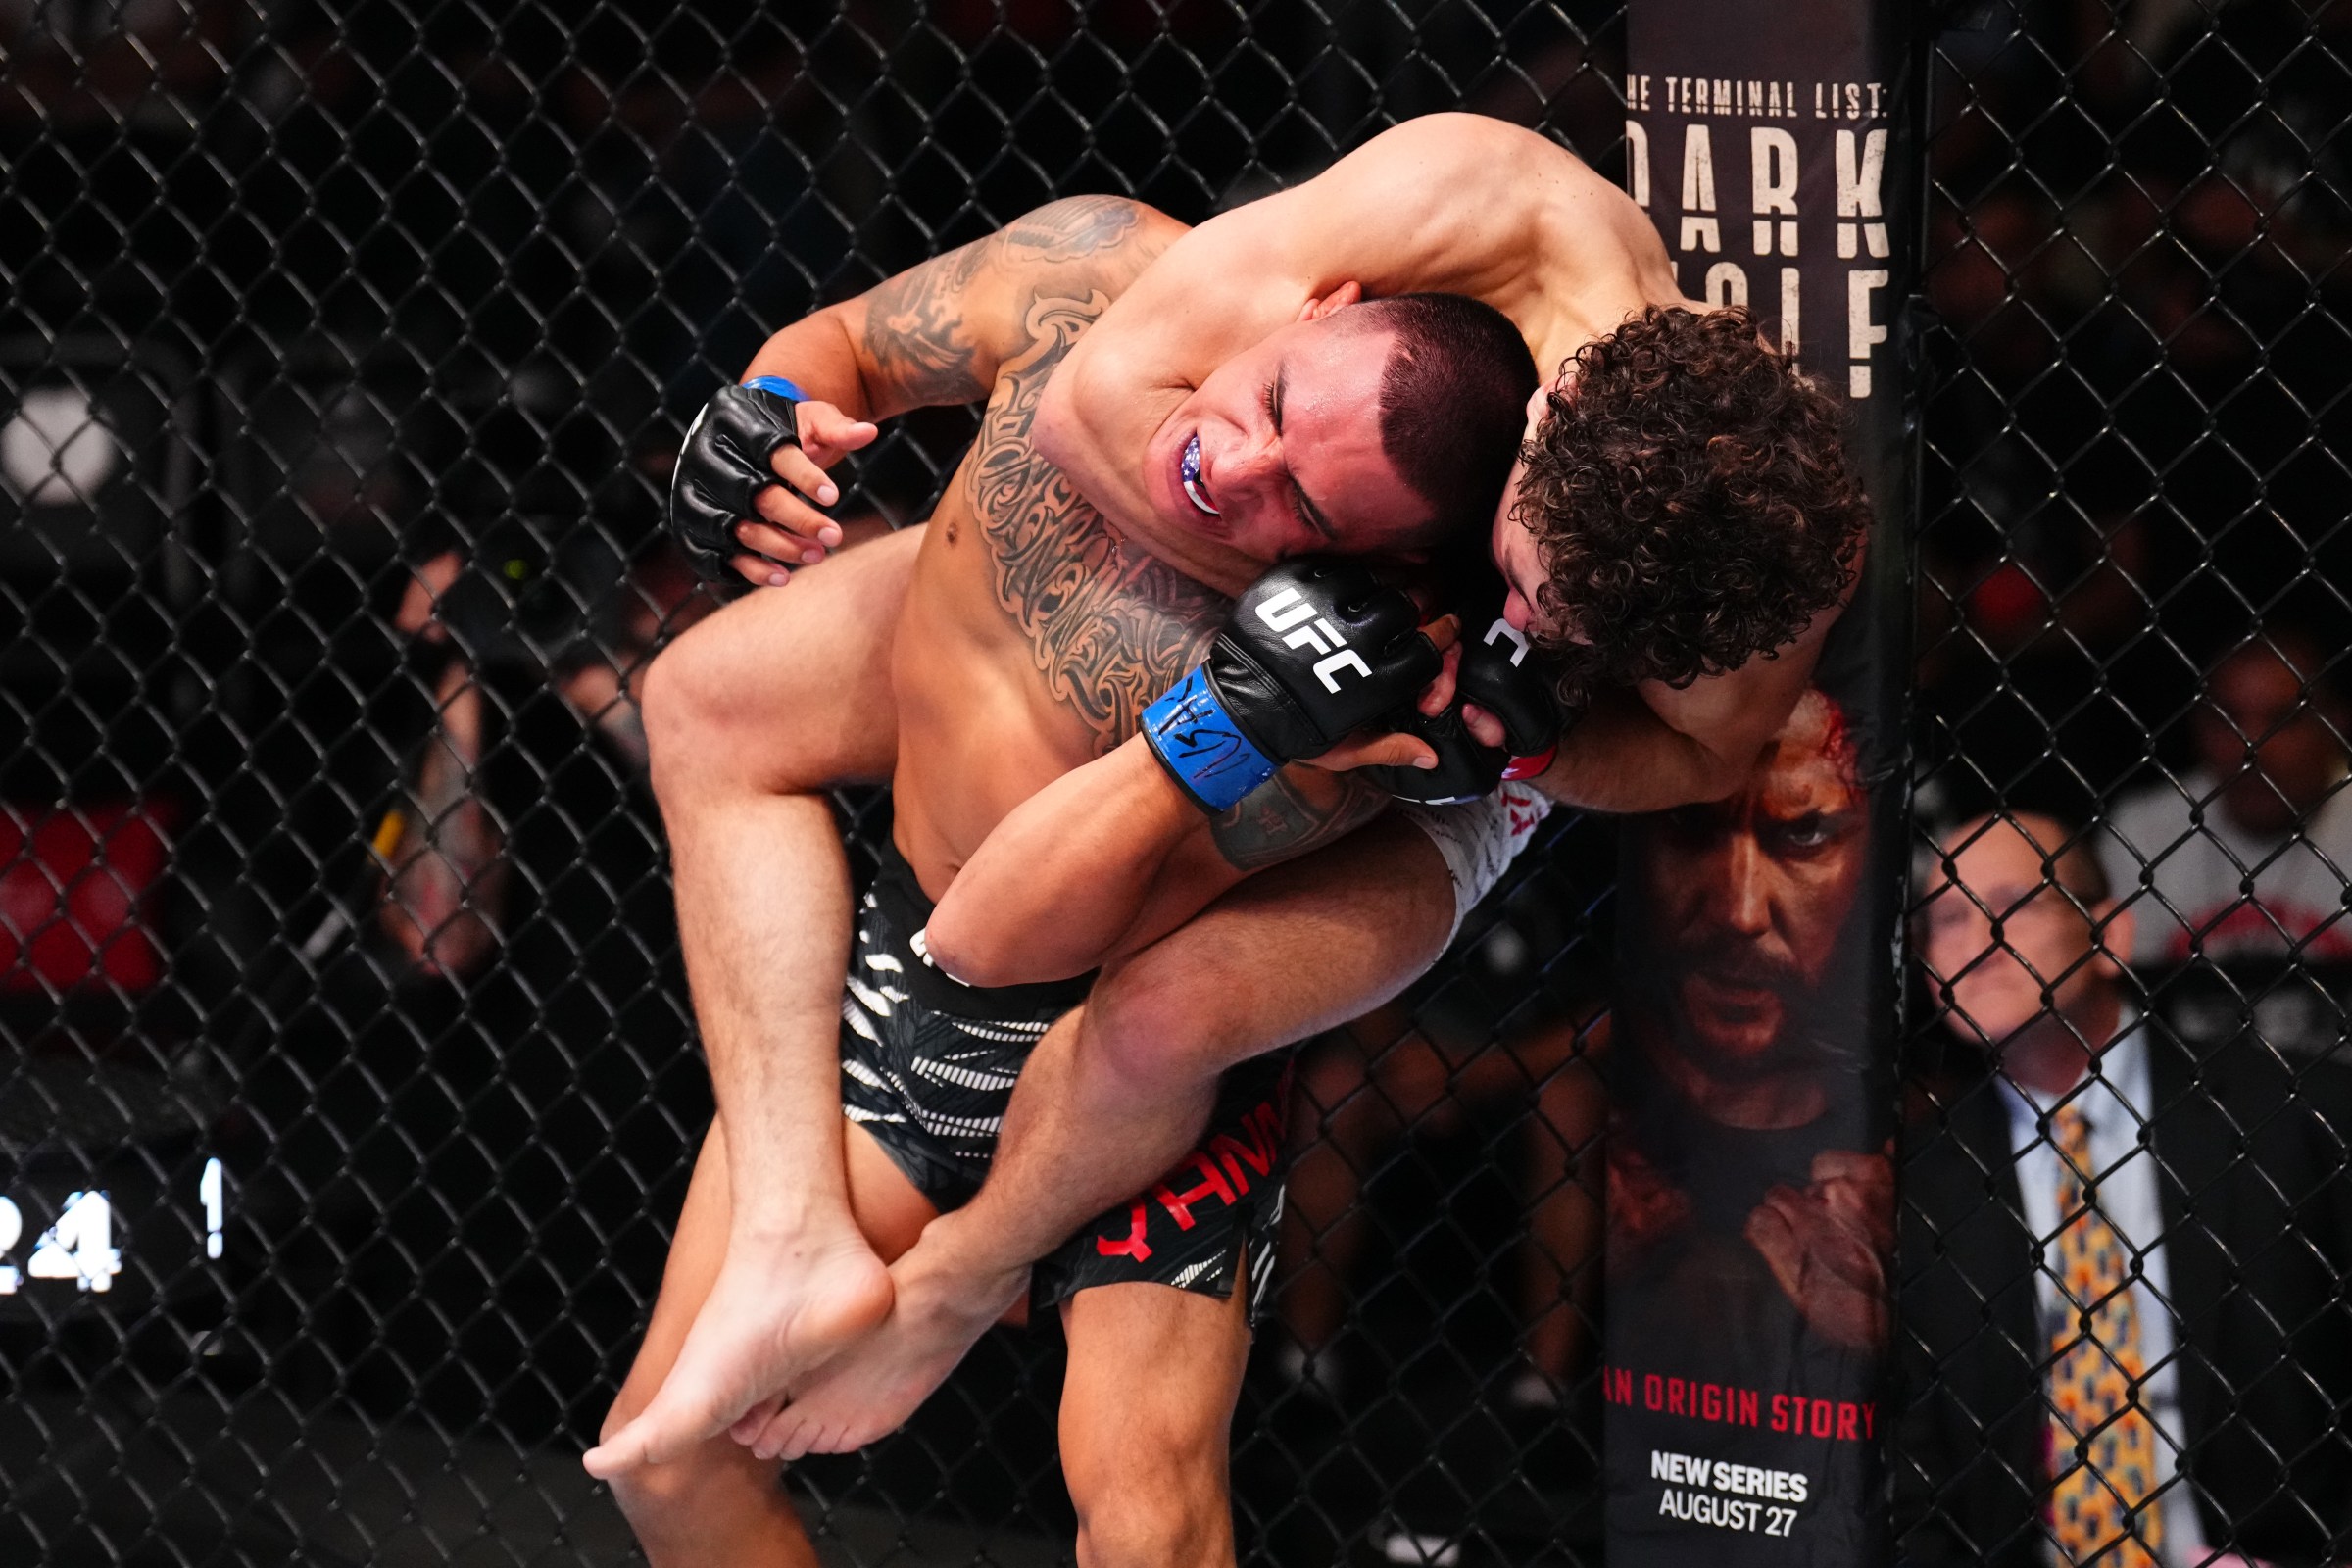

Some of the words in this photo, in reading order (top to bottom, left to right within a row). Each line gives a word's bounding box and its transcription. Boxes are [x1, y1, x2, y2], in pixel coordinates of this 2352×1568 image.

[1626, 74, 1651, 111] HE
[1666, 76, 1798, 117] TERMINAL
[1255, 587, 1373, 694] UFC
[1644, 1374, 1759, 1427] ORIGIN
[1771, 1393, 1877, 1441] STORY
[1651, 1450, 1711, 1488] NEW
[1713, 1461, 1808, 1502] SERIES
[1659, 1489, 1762, 1532] AUGUST
[1765, 1508, 1797, 1537] 27
